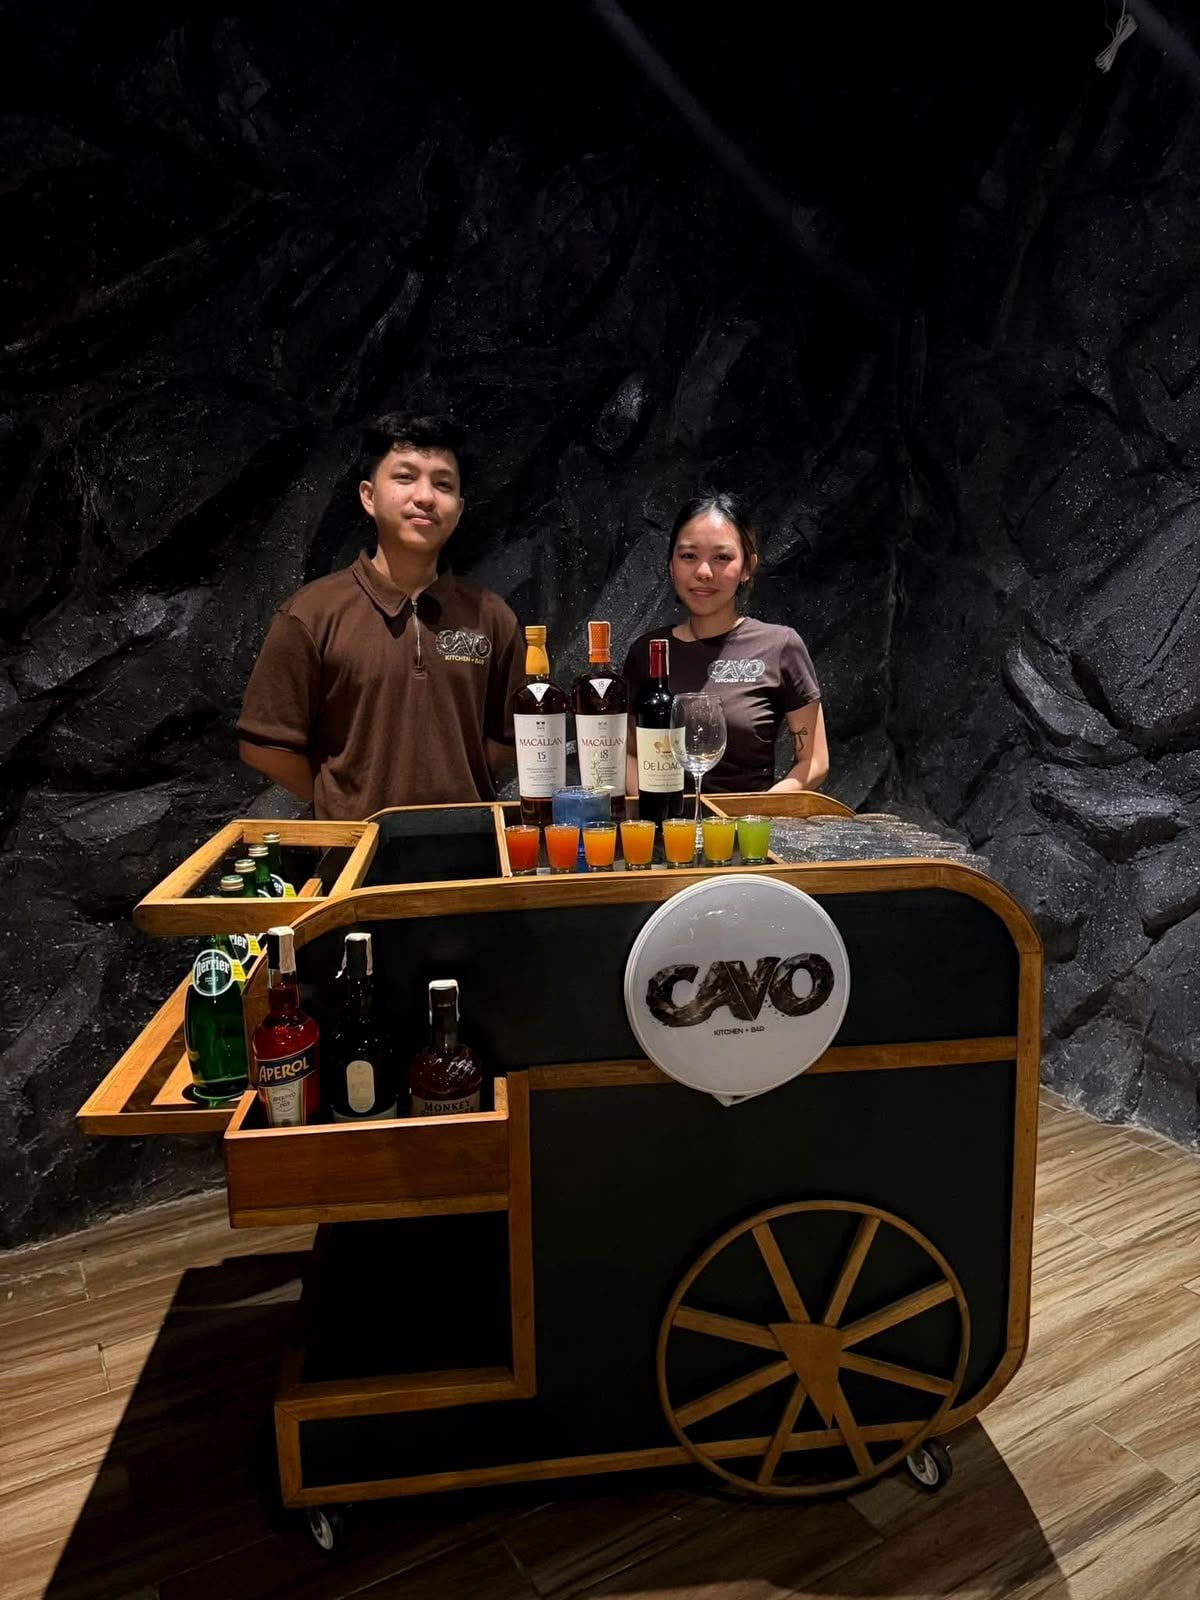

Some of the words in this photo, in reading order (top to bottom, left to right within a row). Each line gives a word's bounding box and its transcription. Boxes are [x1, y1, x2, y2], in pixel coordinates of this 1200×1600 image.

[436, 630, 492, 658] CAVO
[444, 654, 471, 662] KITCHEN
[710, 659, 766, 679] CAVO
[519, 738, 563, 747] MACALLAN
[581, 738, 624, 747] MACALLAN
[537, 752, 546, 760] 15
[600, 750, 609, 759] 18
[645, 953, 835, 1028] CAVO
[713, 1028, 744, 1036] KITCHEN
[259, 1056, 310, 1082] APEROL
[424, 1100, 470, 1112] MONKEY
